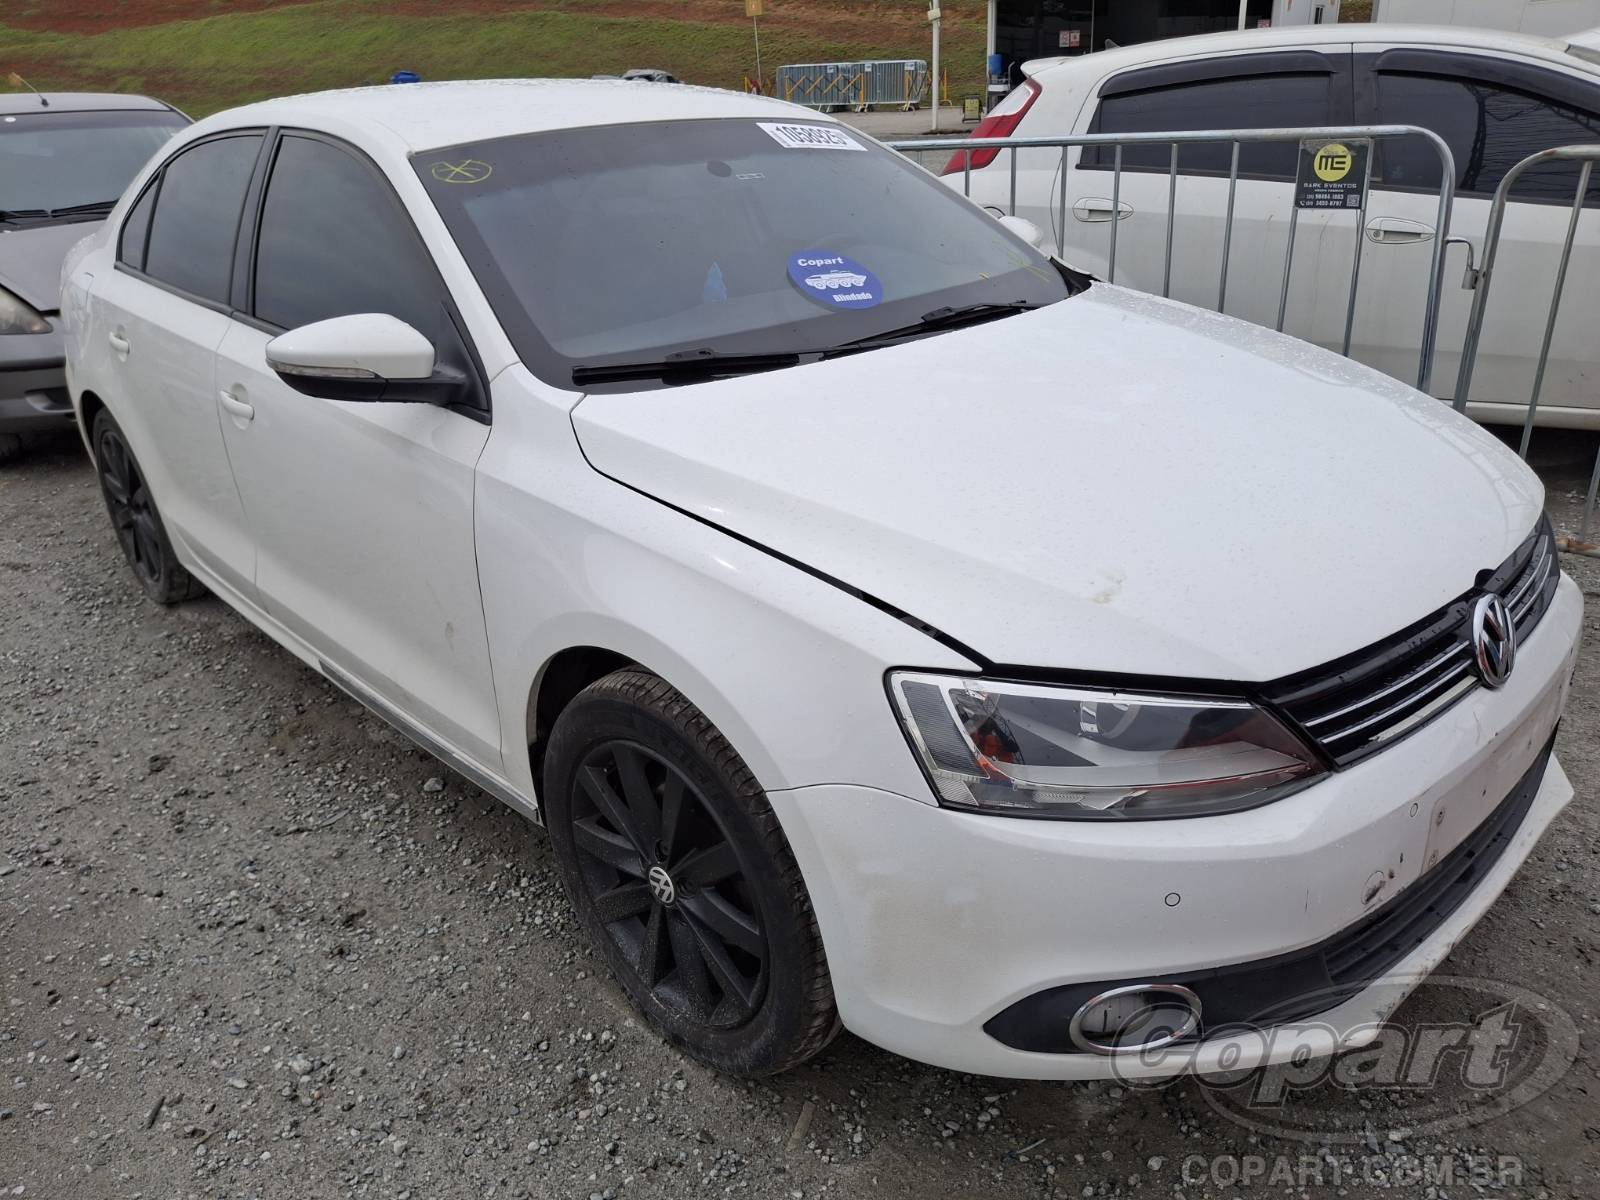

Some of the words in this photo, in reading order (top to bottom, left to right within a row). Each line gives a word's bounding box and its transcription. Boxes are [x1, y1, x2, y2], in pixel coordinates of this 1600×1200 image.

[775, 125, 848, 146] 1058925
[797, 256, 845, 267] Copart
[832, 291, 873, 303] Blindado
